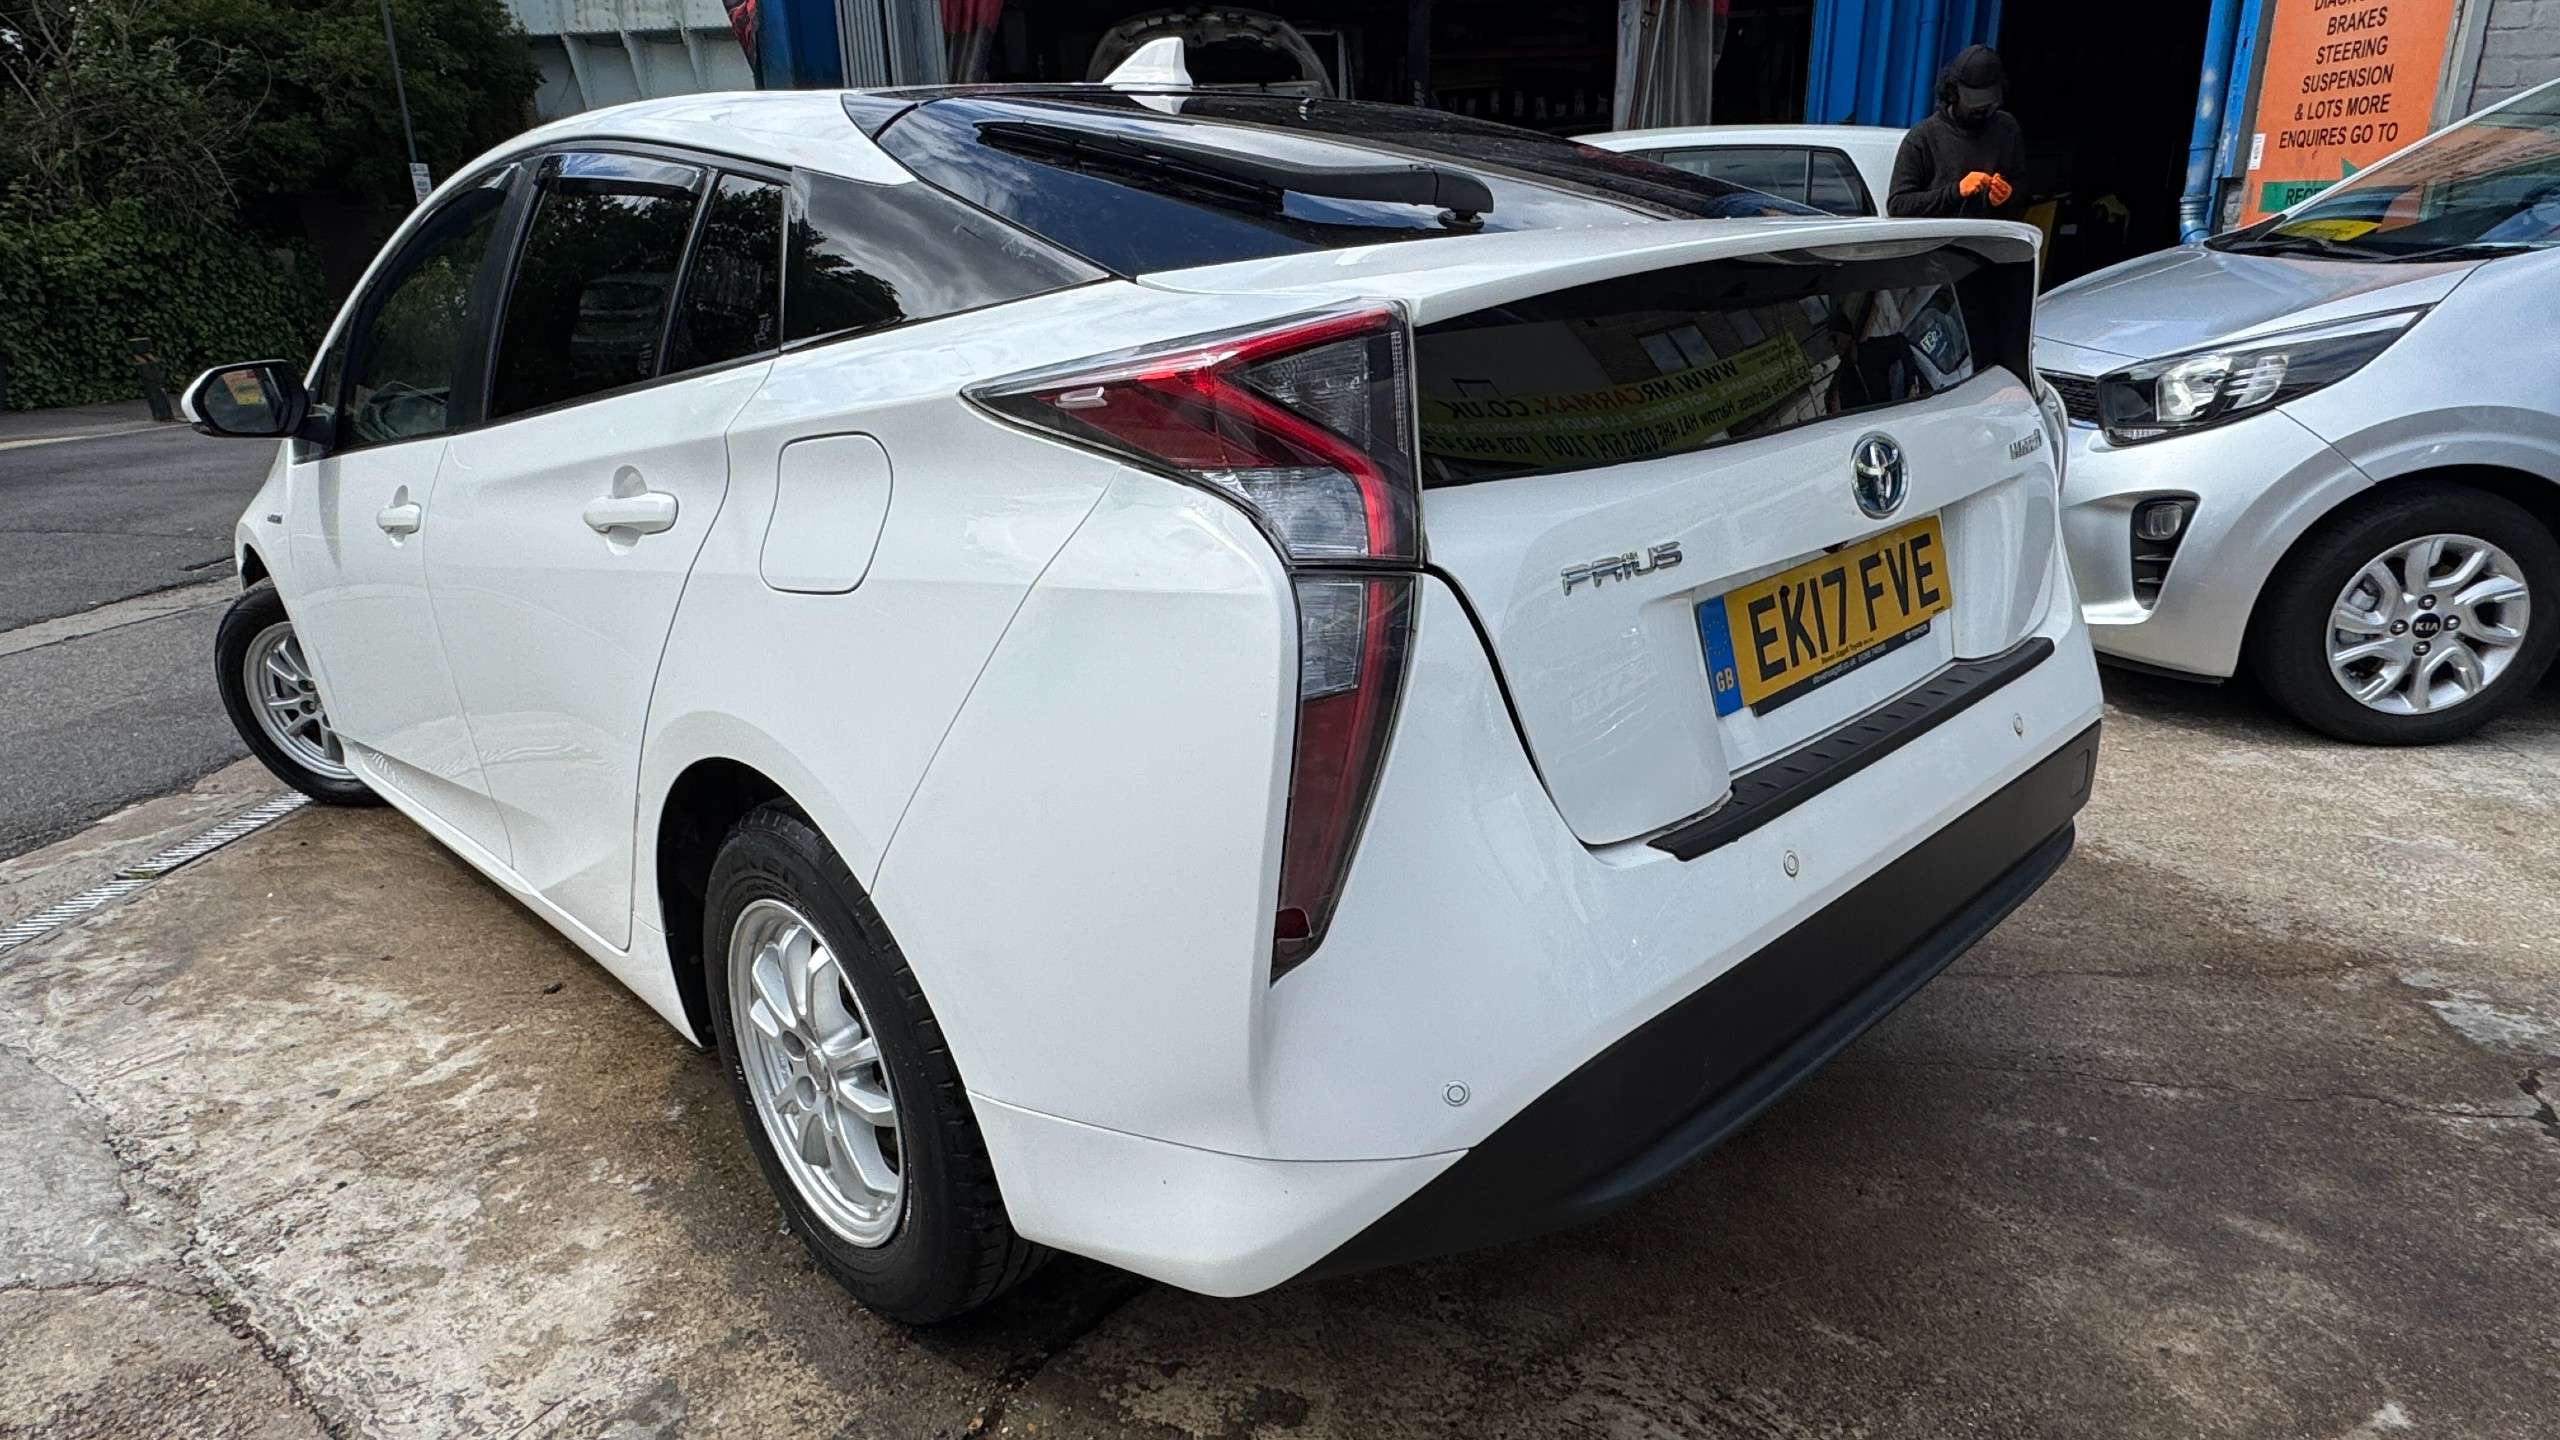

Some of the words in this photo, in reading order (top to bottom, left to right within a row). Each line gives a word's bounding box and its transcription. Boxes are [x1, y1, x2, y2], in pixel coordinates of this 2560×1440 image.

[2326, 7, 2389, 36] BRAKES
[2315, 36, 2389, 65] STEERING
[2301, 64, 2395, 95] SUSPENSION
[2294, 104, 2304, 121] &
[2307, 99, 2343, 119] LOTS
[2345, 94, 2392, 116] MORE
[2279, 126, 2347, 149] ENQUIRES
[2350, 125, 2373, 143] GO
[2379, 122, 2398, 142] TO
[1560, 541, 1682, 596] PRIUS
[1748, 566, 1847, 682] EK17
[1858, 533, 1940, 632] FVE
[2415, 622, 2438, 631] KIA
[1716, 669, 1735, 693] GB
